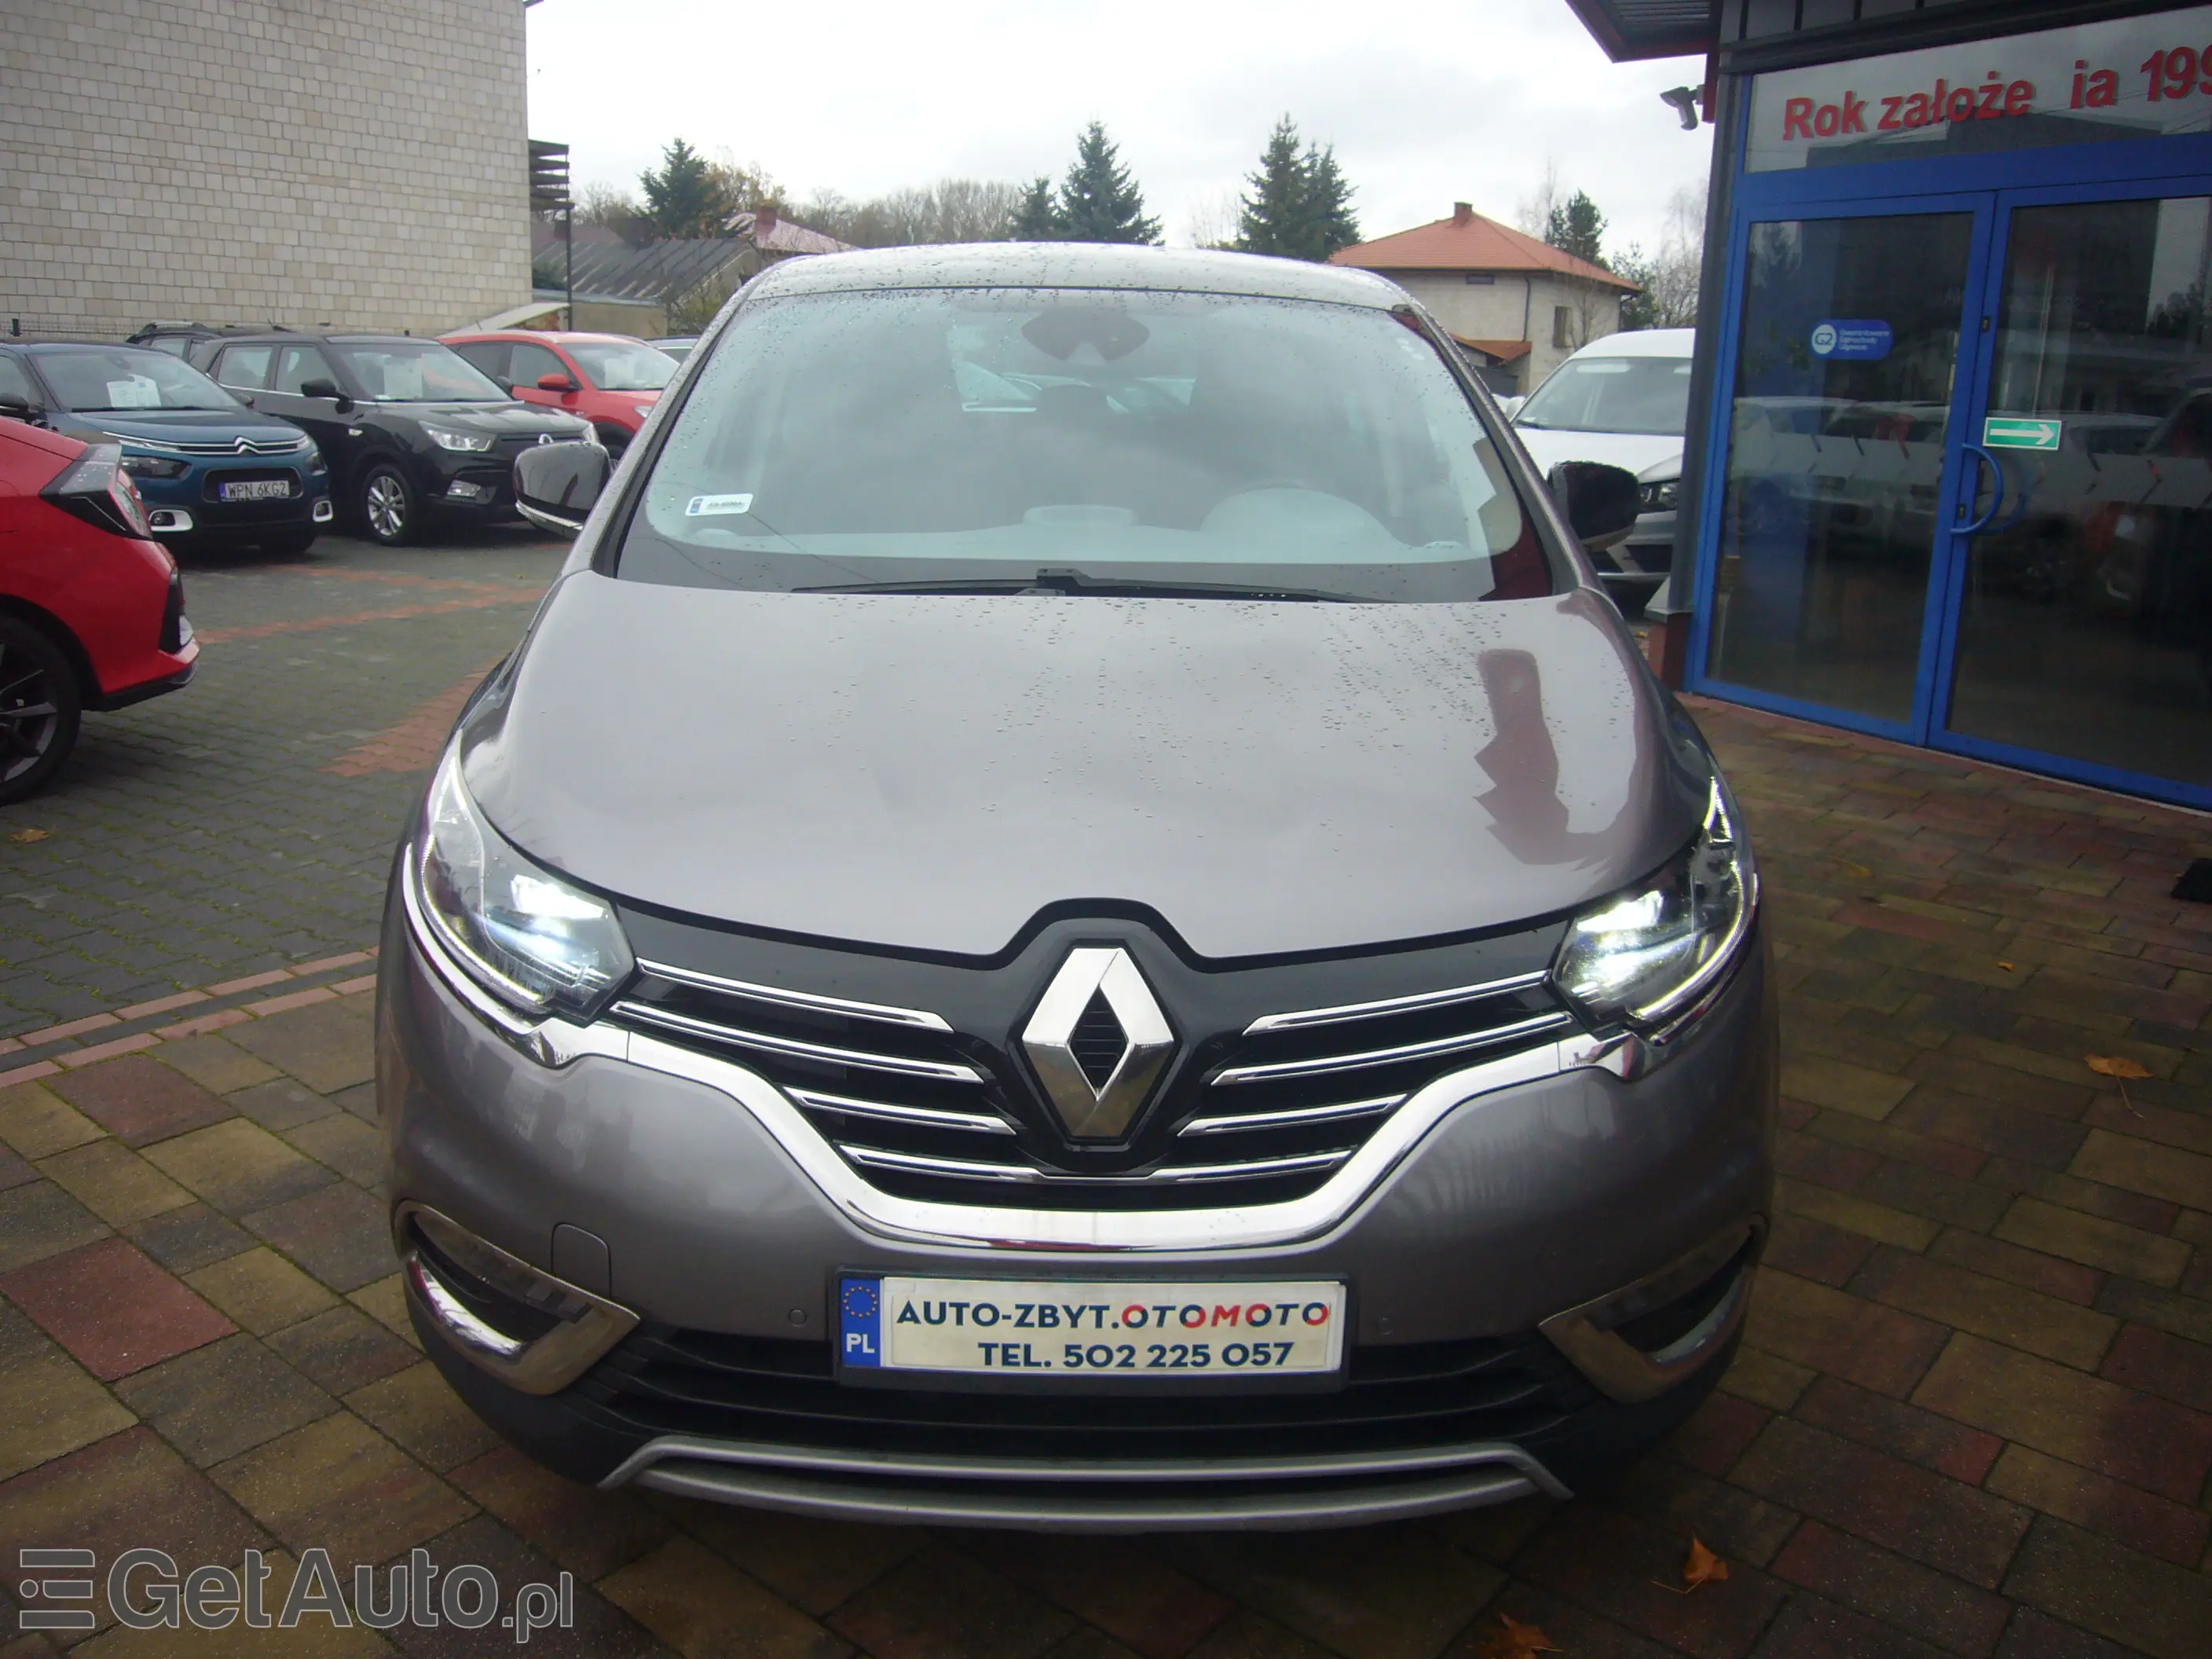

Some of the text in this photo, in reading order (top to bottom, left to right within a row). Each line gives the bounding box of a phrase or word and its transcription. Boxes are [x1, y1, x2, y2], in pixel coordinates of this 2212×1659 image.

[1782, 90, 1867, 141] Rok
[227, 483, 253, 498] WPN
[895, 1300, 1329, 1329] AUTO-ZBYT.OTOMOTO
[845, 1332, 876, 1353] PL
[977, 1342, 1295, 1368] TEL. 502 225 057
